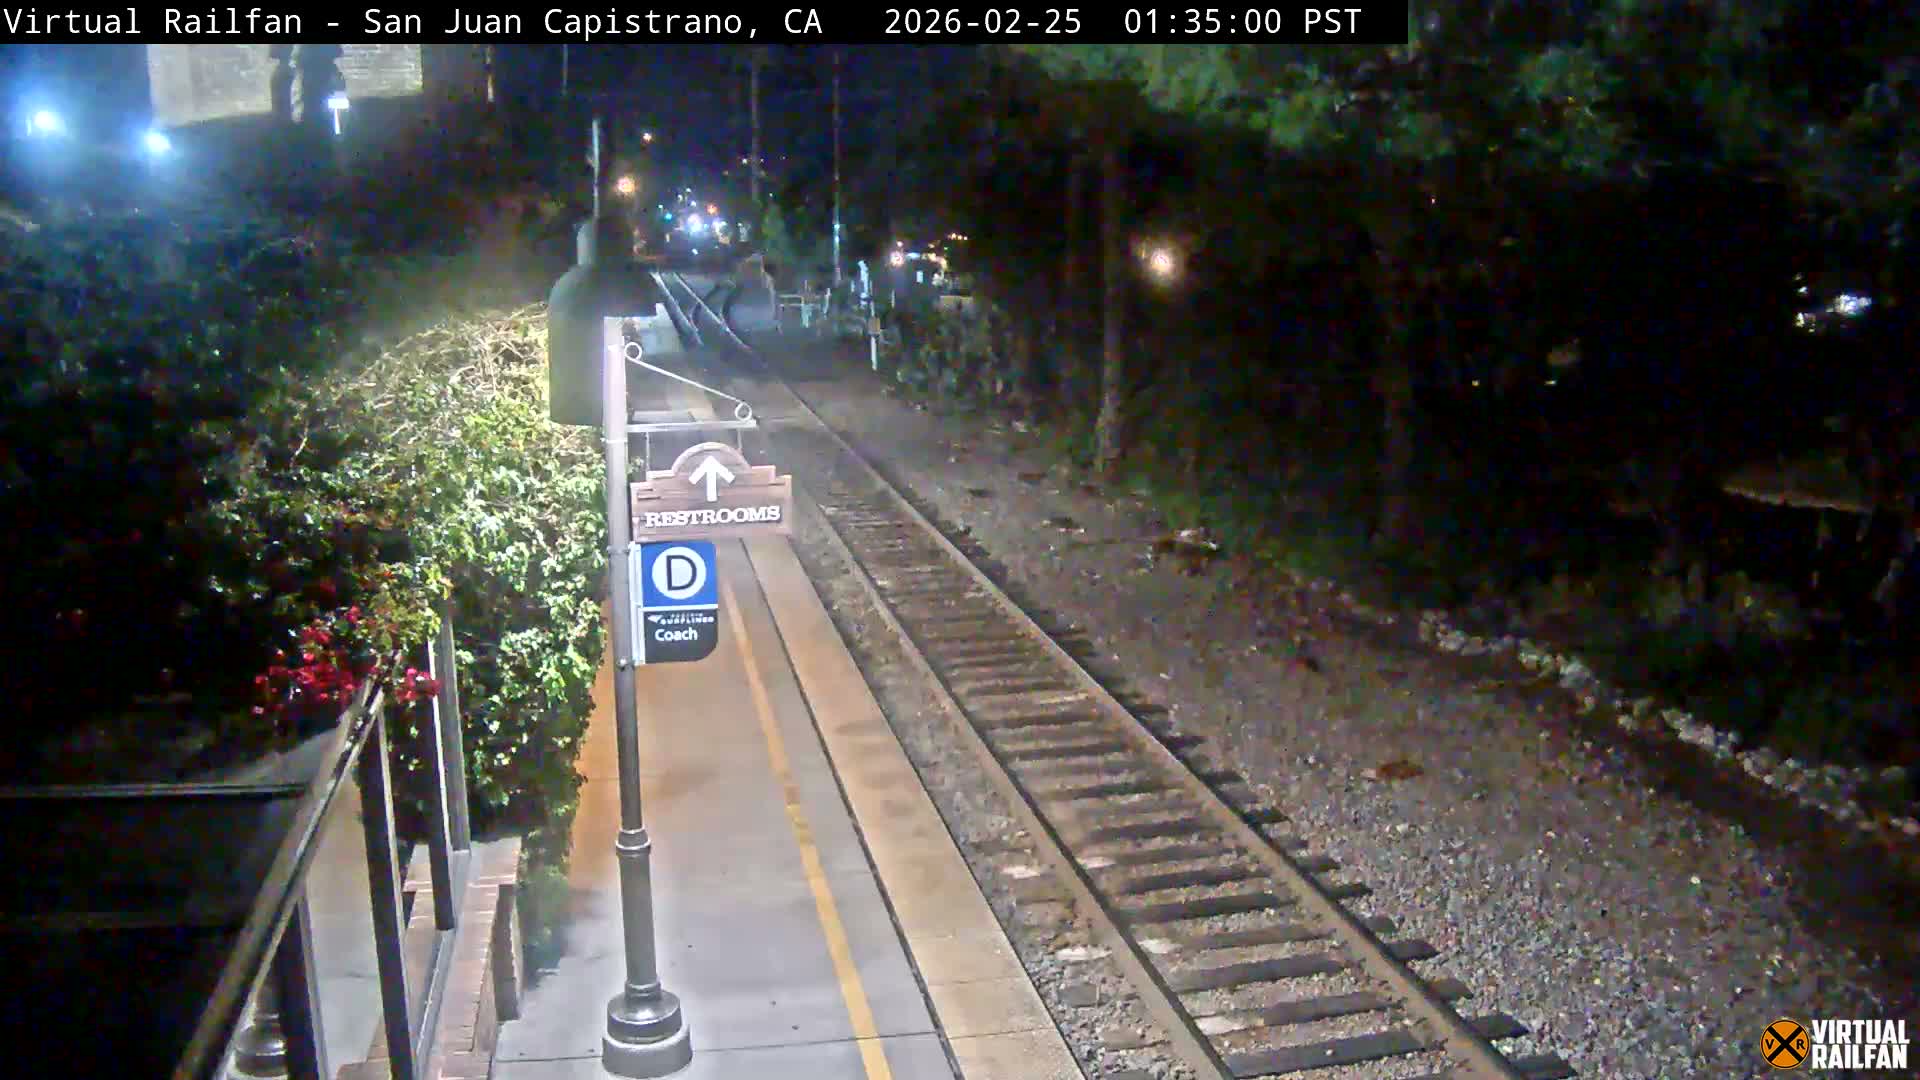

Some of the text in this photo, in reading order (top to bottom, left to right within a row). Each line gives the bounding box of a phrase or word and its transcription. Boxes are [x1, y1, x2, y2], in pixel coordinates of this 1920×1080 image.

[644, 505, 781, 528] RESTROOMS
[666, 555, 697, 591] D
[655, 627, 698, 641] Coach
